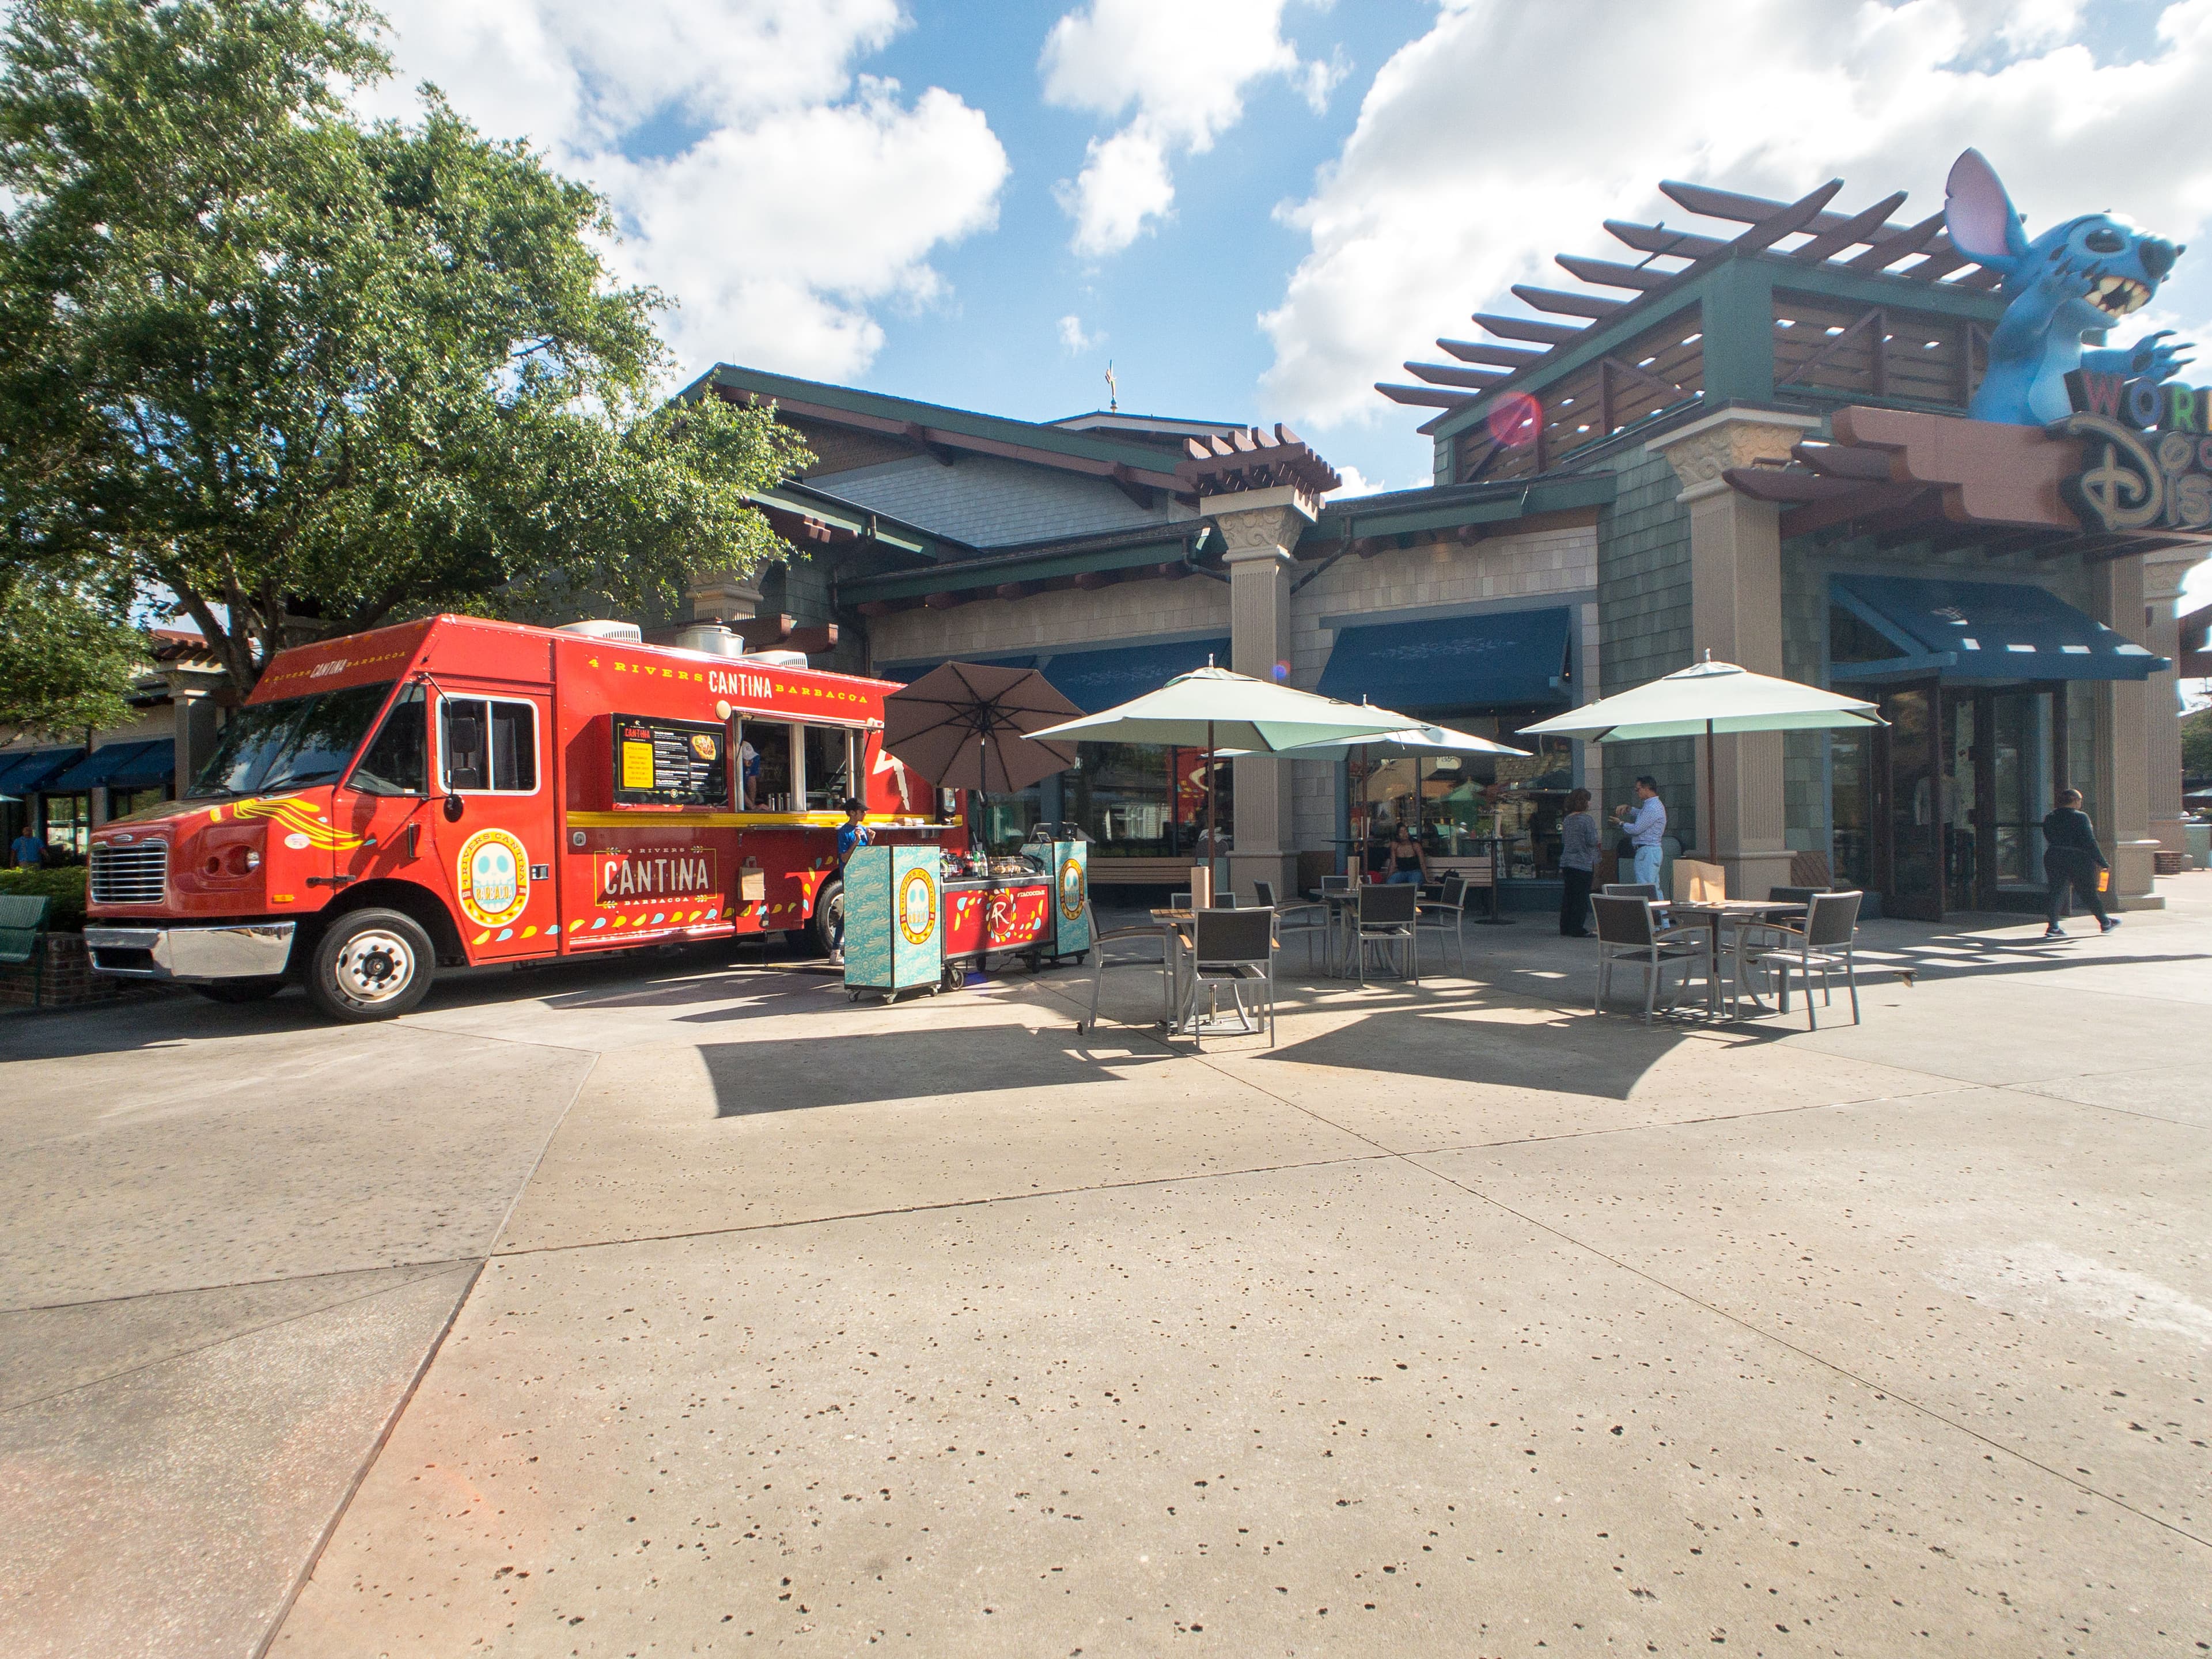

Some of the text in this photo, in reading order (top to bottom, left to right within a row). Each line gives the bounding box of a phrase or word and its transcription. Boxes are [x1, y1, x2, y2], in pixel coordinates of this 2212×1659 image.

[2082, 372, 2212, 431] WOR
[272, 669, 312, 682] RIVERS
[310, 659, 347, 678] CANTINA
[346, 651, 406, 668] BARBACOA
[588, 658, 868, 703] 4 RIVERS CANTINA BARBACOA
[624, 728, 650, 738] CANTINA
[462, 833, 491, 875] RIVERS
[494, 833, 525, 881] CANTINA
[476, 885, 513, 901] BARBACOA
[604, 857, 709, 896] CANTINA
[624, 897, 689, 906] BARBACOA
